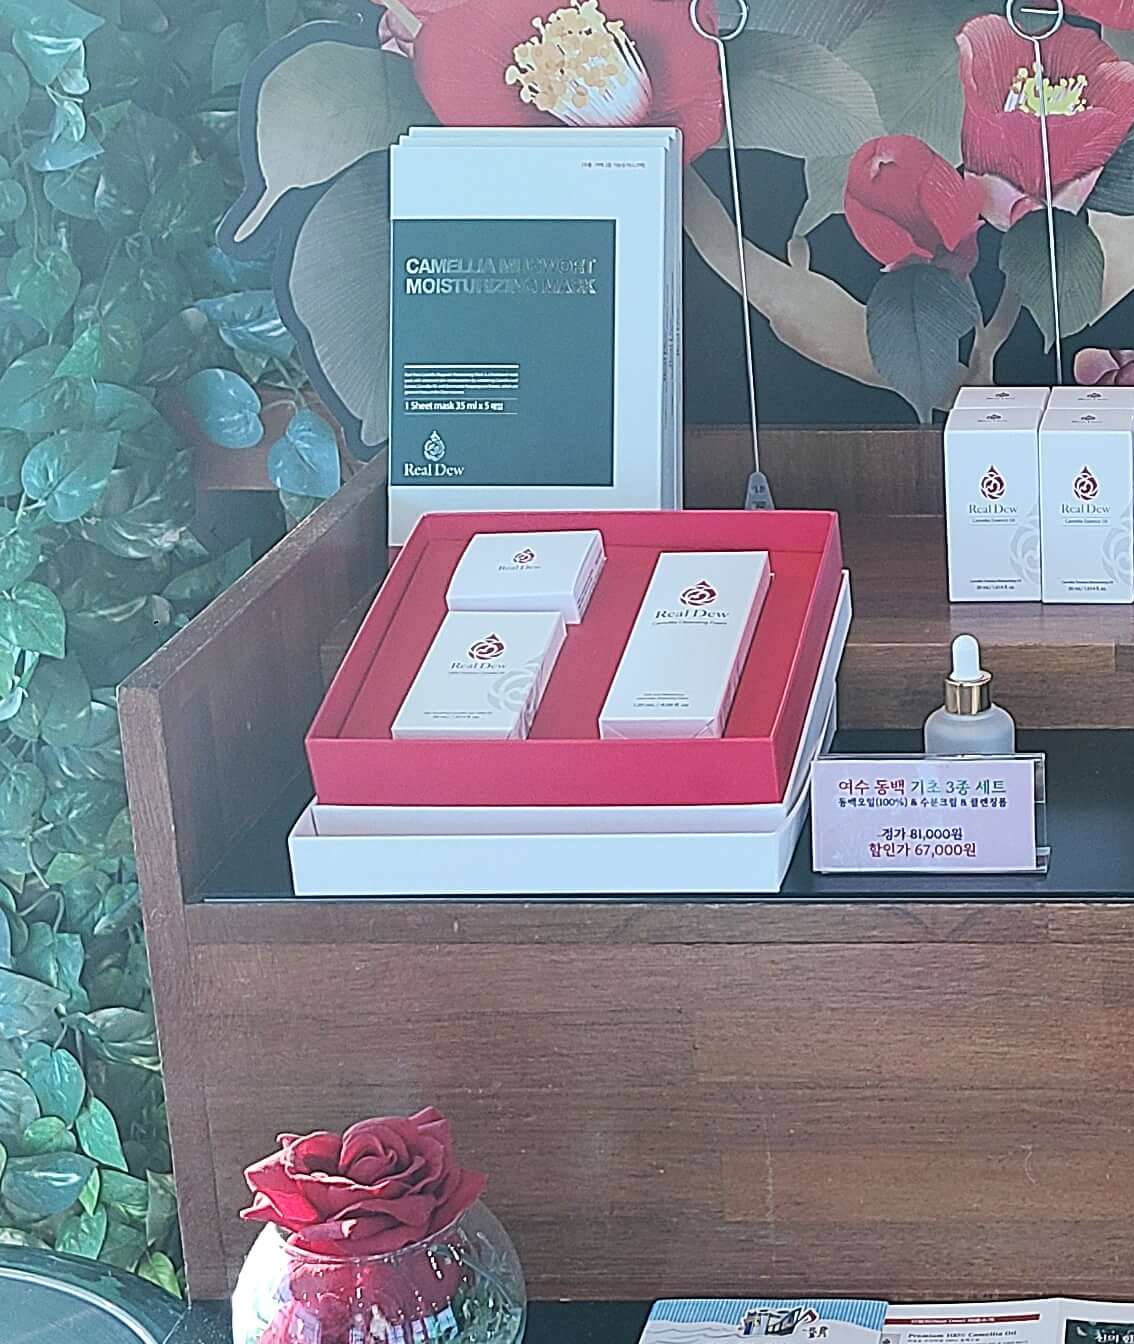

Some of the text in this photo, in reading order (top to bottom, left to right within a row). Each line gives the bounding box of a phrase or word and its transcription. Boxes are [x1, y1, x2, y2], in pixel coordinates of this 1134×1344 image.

[406, 258, 496, 274] CAMELLIA
[404, 463, 464, 476] Real Dew
[969, 503, 1017, 514] Real Dew
[1062, 504, 1110, 514] Real Dew
[656, 609, 730, 618] Real Dew
[450, 660, 506, 670] Real Dew
[838, 779, 1007, 795] 여수 동백 기초 3종 세트
[838, 797, 908, 808] 동백오일(100%)
[920, 797, 957, 807] 수분크림
[970, 797, 1008, 807] 클렌징폼
[881, 827, 962, 842] 정가 81,000원
[870, 842, 976, 858] 할인가 67,000원
